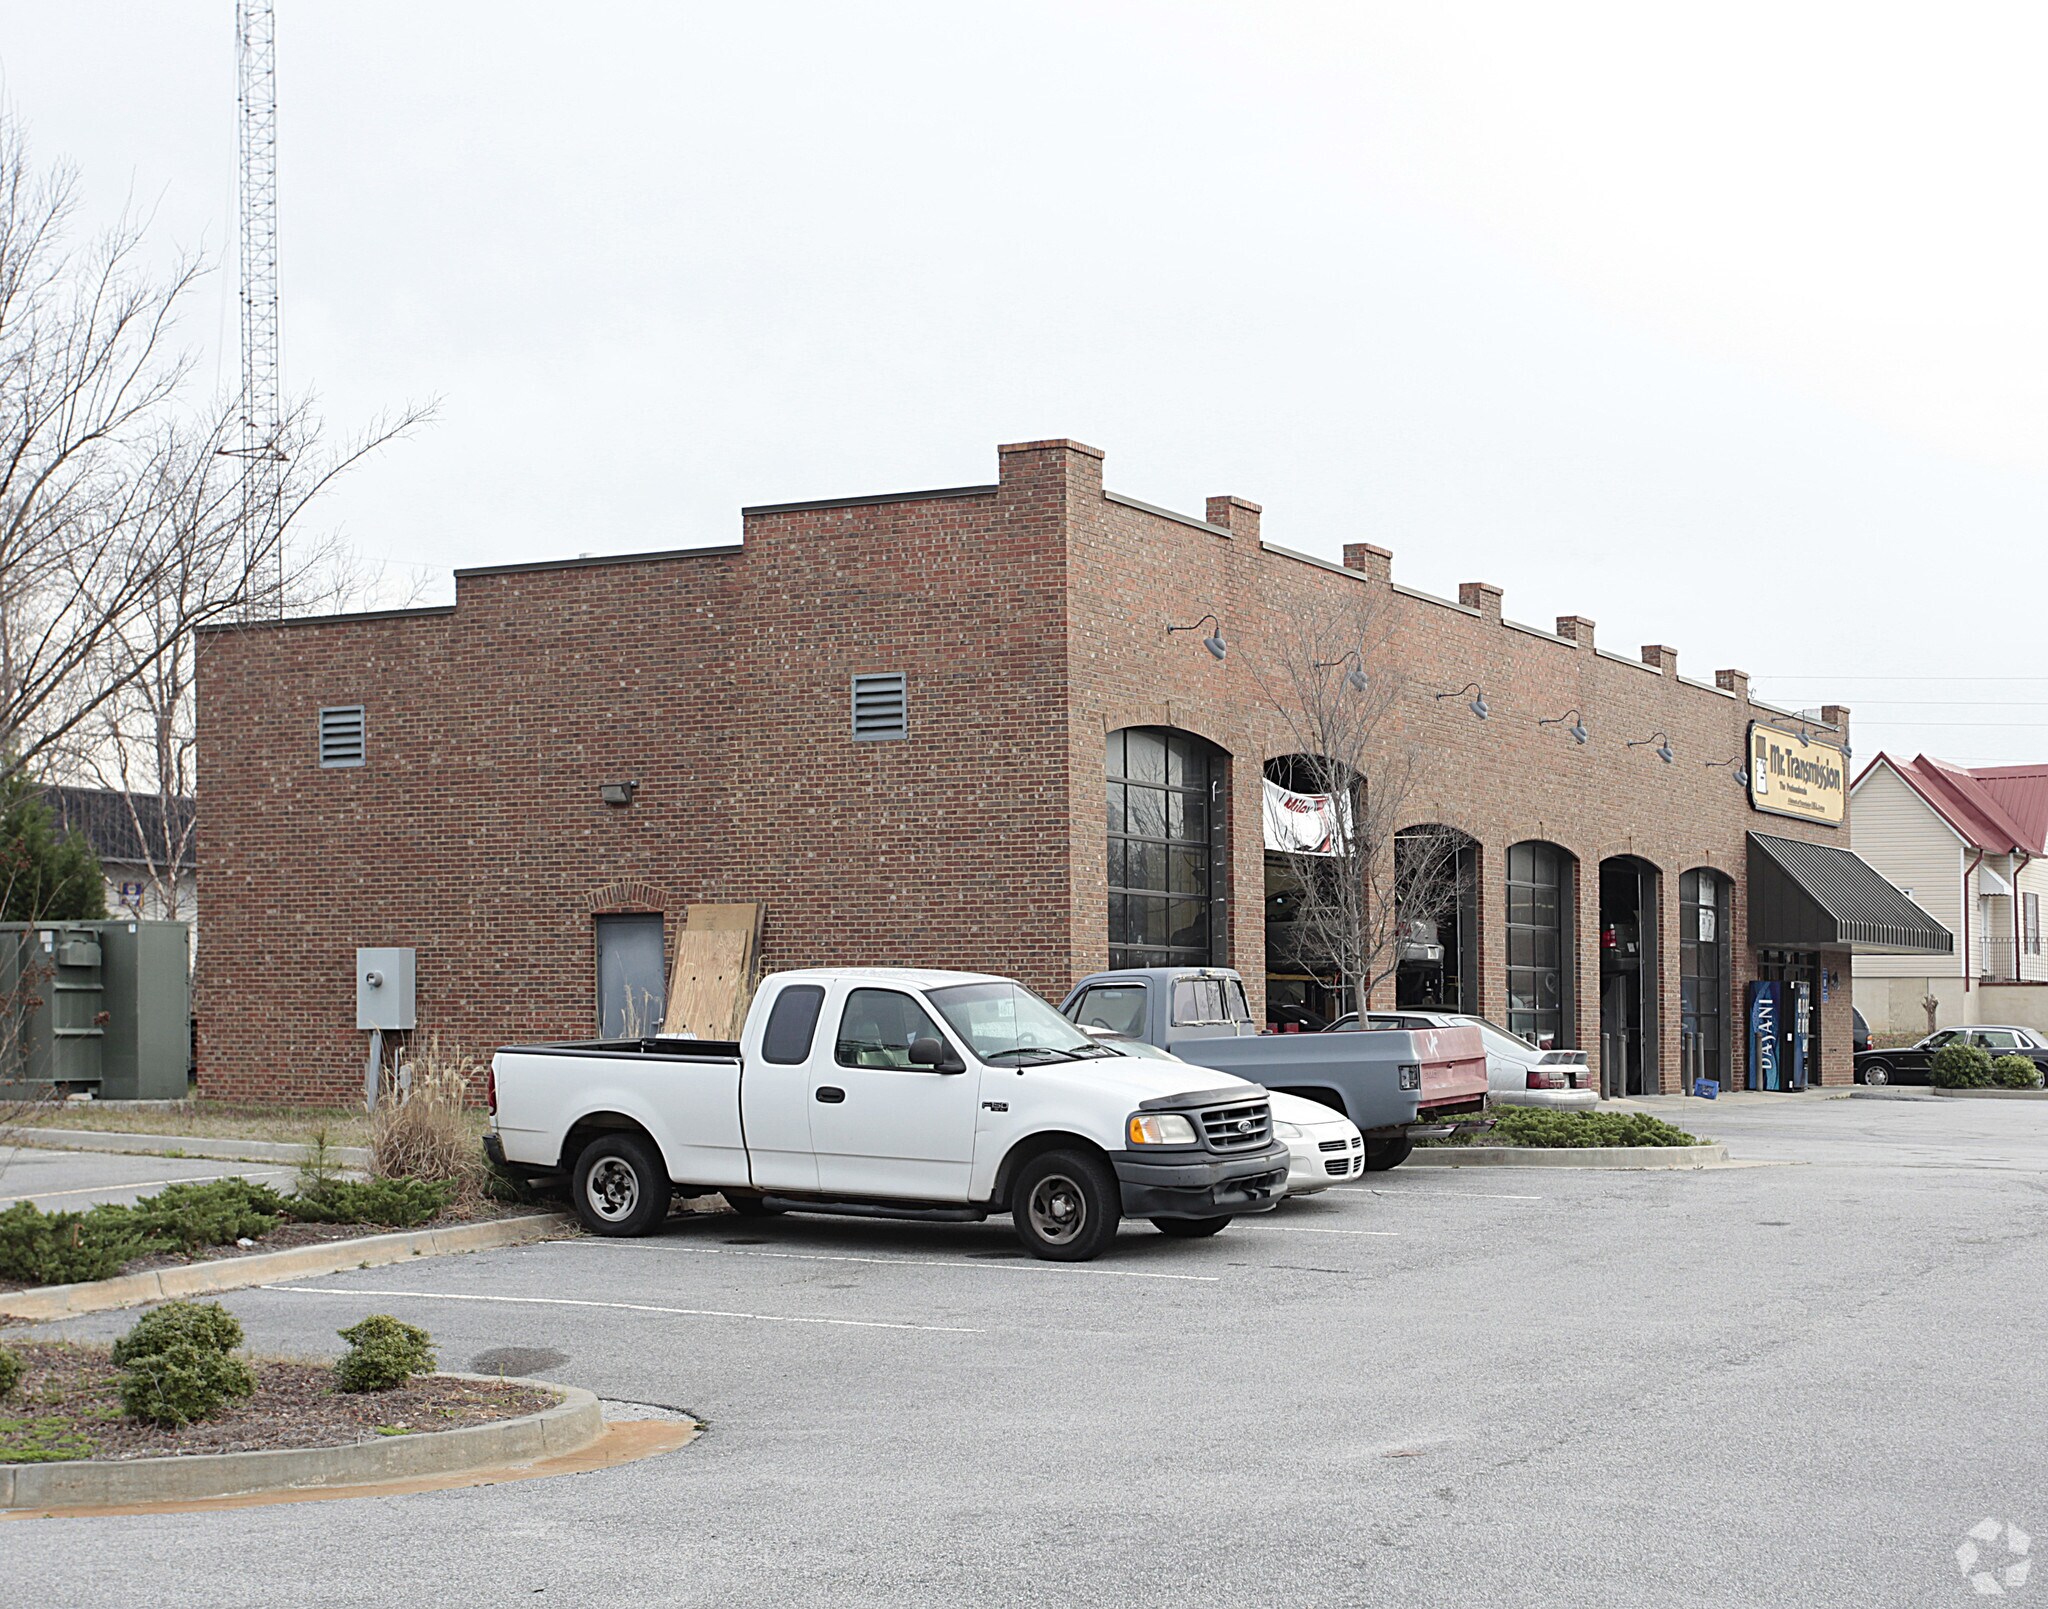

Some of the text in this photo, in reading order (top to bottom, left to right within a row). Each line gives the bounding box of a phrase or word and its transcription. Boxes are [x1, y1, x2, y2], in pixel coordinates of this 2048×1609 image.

[1770, 744, 1841, 791] Mr. Transmission
[1758, 999, 1777, 1070] DASANI
